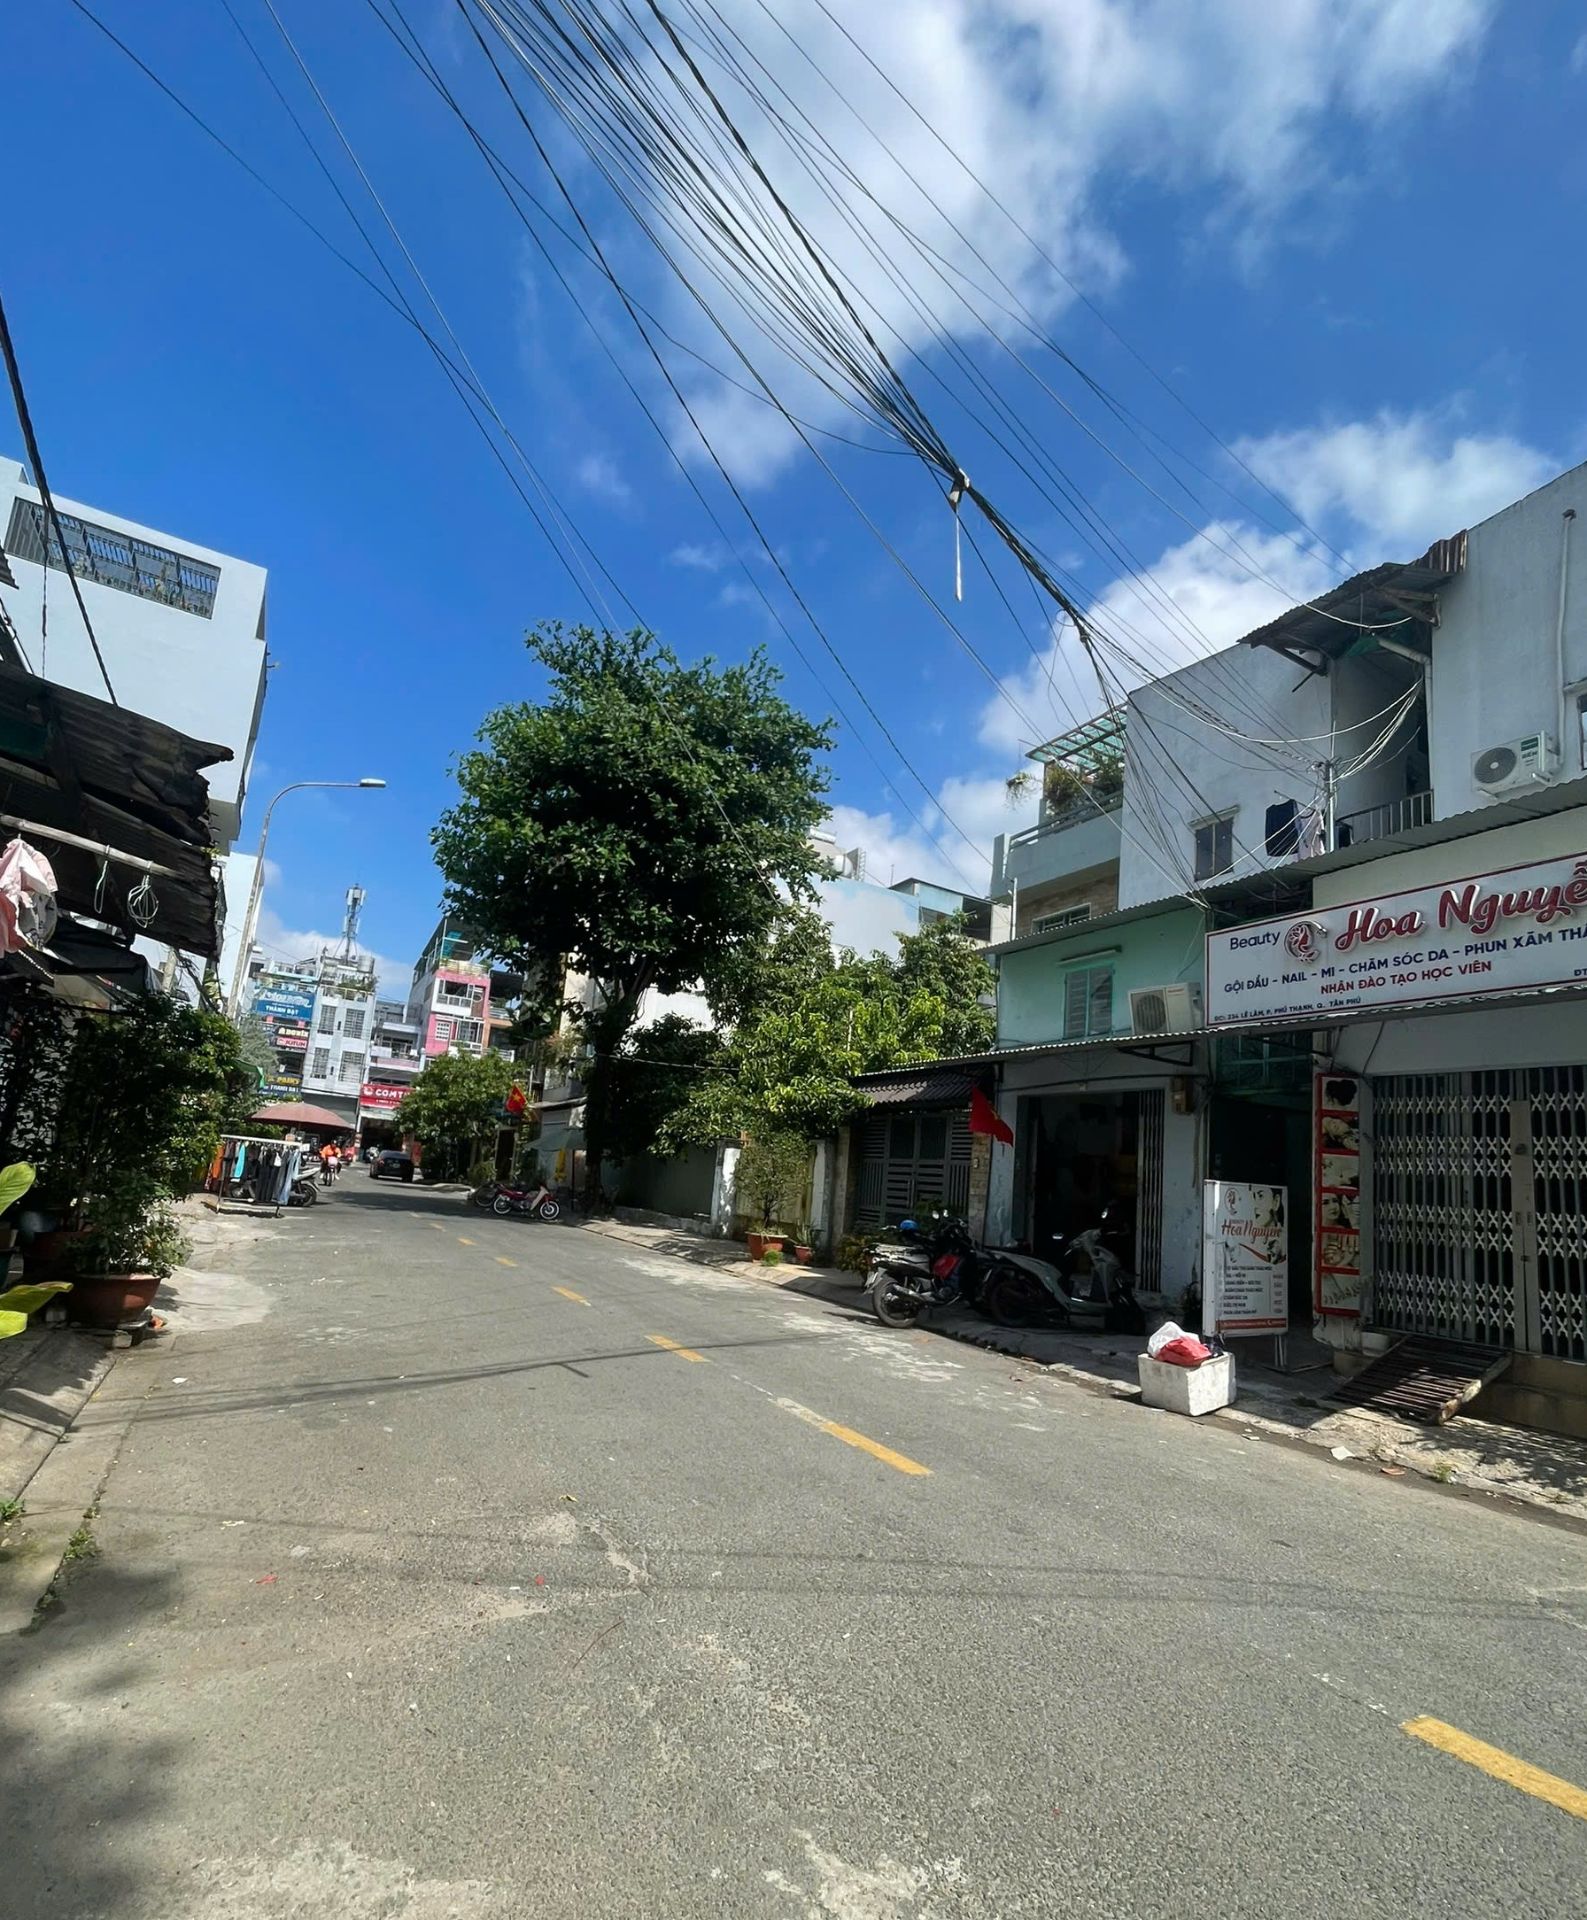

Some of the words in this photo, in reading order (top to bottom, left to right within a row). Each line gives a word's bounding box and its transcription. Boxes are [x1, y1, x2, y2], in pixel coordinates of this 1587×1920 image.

[1230, 931, 1281, 951] Beauty
[1334, 907, 1425, 952] Hoa
[1224, 979, 1244, 994] GỘI
[1281, 971, 1307, 985] NAIL
[1321, 966, 1335, 978] MI
[1392, 951, 1424, 967] SÓC
[1428, 948, 1449, 962] DA
[1464, 938, 1507, 956] PHUN
[1320, 980, 1354, 995] NHẬN
[1358, 975, 1386, 989] ĐÀO
[1389, 971, 1417, 987] TẠO
[1421, 966, 1453, 982] HỌC
[1457, 959, 1492, 975] VIÊN
[1221, 1219, 1243, 1237] Hoa
